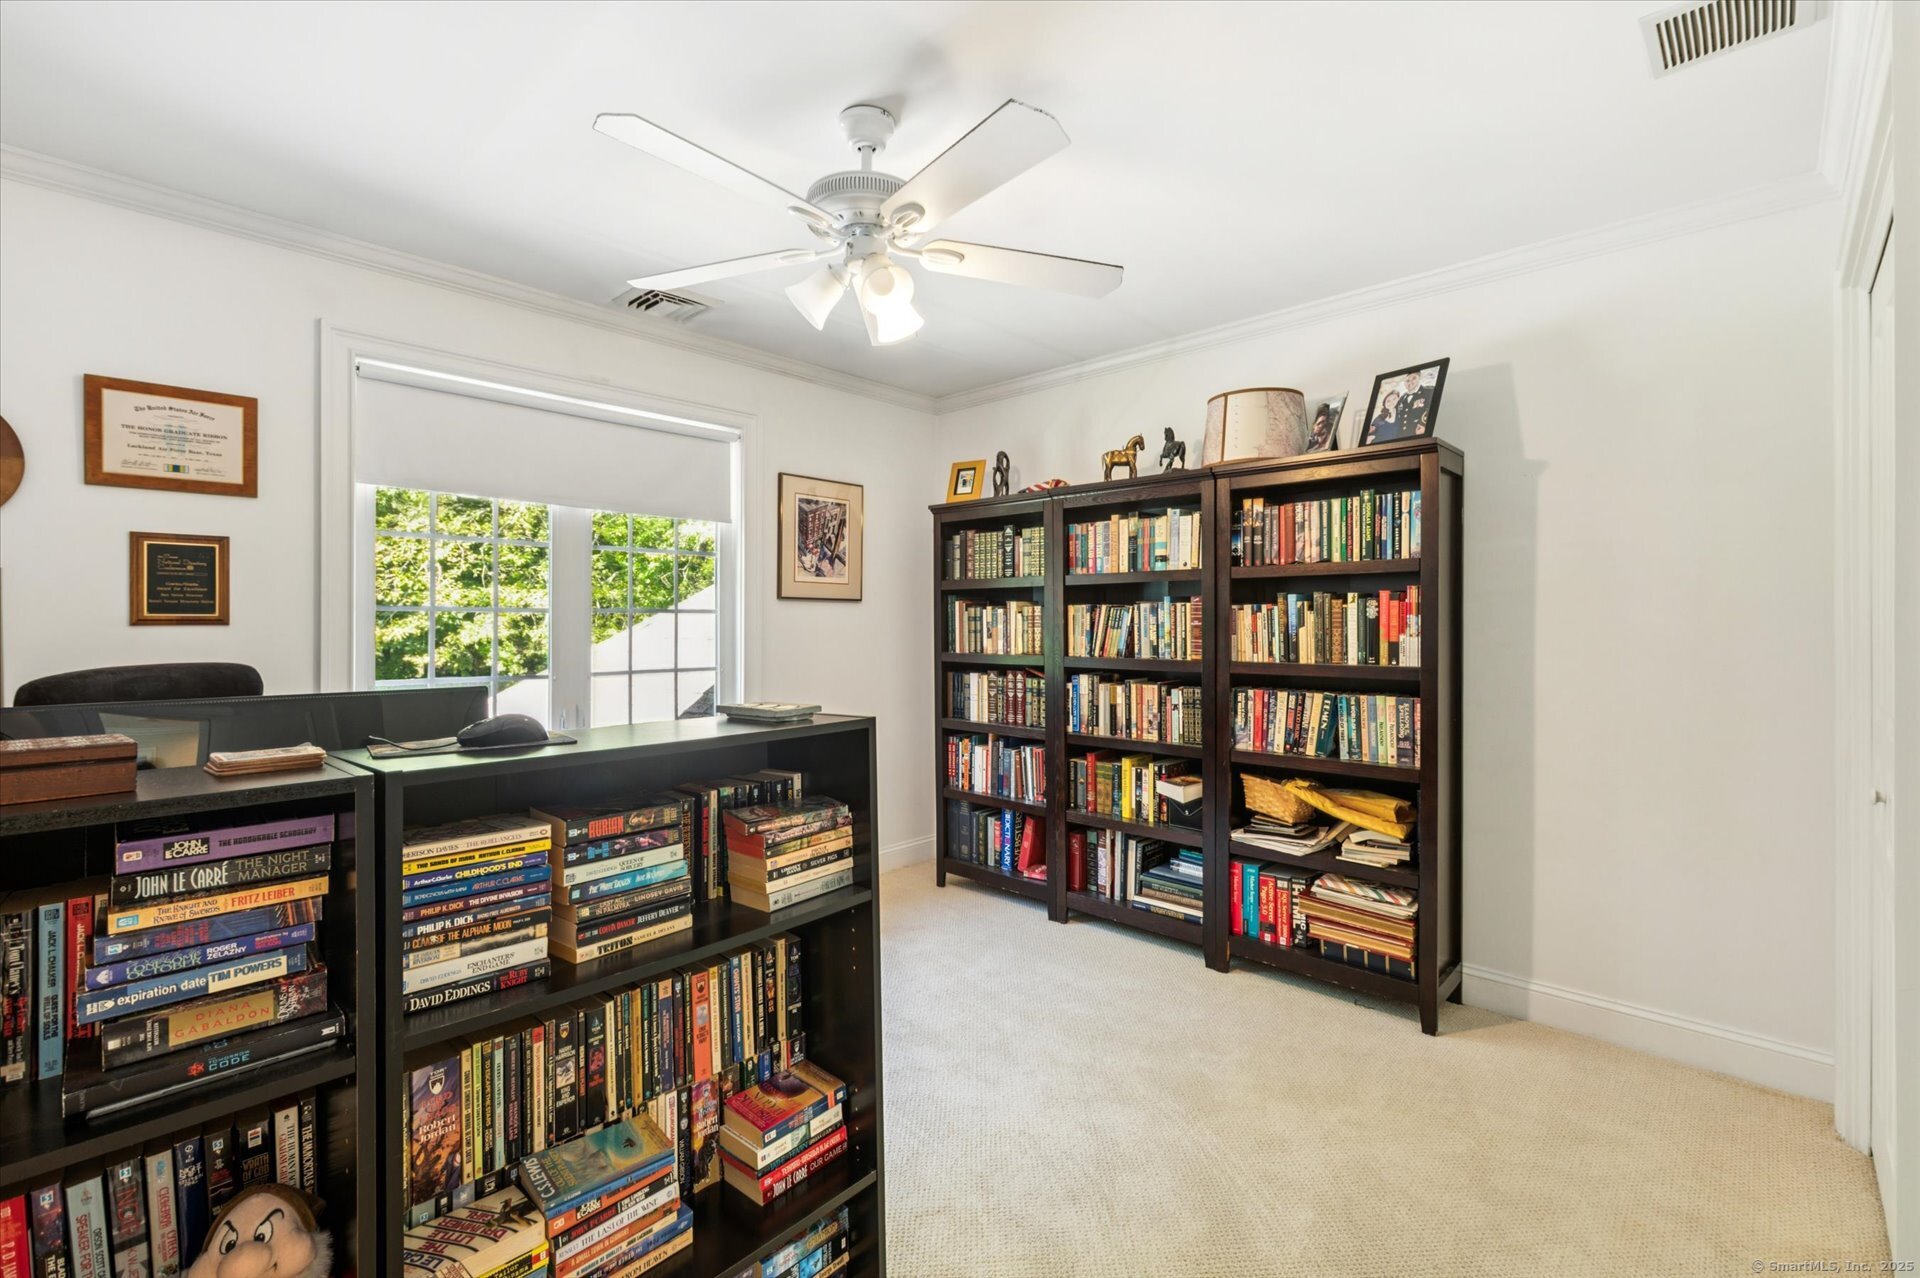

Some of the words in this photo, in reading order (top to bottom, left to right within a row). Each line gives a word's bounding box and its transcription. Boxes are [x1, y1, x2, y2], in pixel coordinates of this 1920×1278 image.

[588, 815, 624, 839] AURIAN
[171, 839, 202, 851] JOHN
[218, 838, 232, 848] THE
[235, 859, 263, 870] THE
[267, 850, 310, 865] NIGHT
[417, 861, 428, 869] THE
[429, 859, 449, 868] SANDS
[458, 854, 476, 862] MARS
[454, 861, 507, 879] CHILDHOOD'S
[508, 860, 524, 869] END
[810, 857, 826, 867] SILVER
[827, 853, 838, 862] PIGS
[134, 875, 168, 899] JOHN
[173, 871, 186, 893] LE
[190, 861, 229, 889] CARRÉ
[238, 861, 307, 882] MANAGER
[231, 894, 260, 908] FRITZ
[262, 887, 295, 903] LEIBER
[420, 905, 442, 916] PHILIP
[442, 904, 449, 912] K.
[449, 901, 465, 911] DICK
[480, 894, 498, 904] DIVINE
[498, 889, 524, 899] INVASION
[634, 890, 663, 902] LINDSEY
[664, 884, 684, 895] DAVIS
[77, 923, 85, 944] JACK
[417, 921, 445, 935] PHILIP
[445, 919, 453, 929] K.
[453, 914, 474, 926] DICK
[448, 930, 461, 940] THE
[461, 924, 491, 938] ALPHANE
[492, 919, 513, 931] MOON
[48, 930, 56, 948] JACK
[206, 942, 238, 954] ROGER
[596, 936, 633, 954] TRITON
[206, 945, 247, 960] ZELAZNY
[47, 955, 57, 988] CHALKER
[127, 961, 201, 980] OCTOBER
[209, 971, 231, 983] TIM
[233, 957, 282, 977] POWERS
[508, 967, 529, 979] RUBY
[117, 980, 178, 1006] expiration
[180, 976, 207, 992] date
[500, 975, 528, 990] KNIGHT
[409, 993, 443, 1012] DAVID
[444, 980, 491, 1002] EDDINGS
[195, 1001, 251, 1022] DIANA
[174, 1007, 270, 1039] GABALDON
[209, 1055, 250, 1071] CODE
[302, 1124, 313, 1143] THE
[419, 1114, 456, 1135] Robert
[419, 1123, 456, 1145] Jordan
[279, 1133, 288, 1164] GRAHAM
[242, 1153, 270, 1173] WRATH
[302, 1143, 313, 1186] IMMORTALS
[523, 1157, 548, 1186] LEWIS
[243, 1170, 253, 1182] OF
[254, 1166, 270, 1180] GOD
[773, 1179, 786, 1198] JOHN
[793, 1163, 808, 1185] CARRÉ
[809, 1155, 824, 1171] OUR
[536, 1180, 556, 1198] C.S.
[465, 1210, 496, 1223] GIRL
[581, 1233, 596, 1247] THE
[597, 1223, 614, 1238] LAST
[615, 1217, 625, 1228] OF
[626, 1208, 639, 1221] THE
[640, 1197, 659, 1212] WINE
[75, 1214, 90, 1254] SPEAKER
[92, 1228, 103, 1250] ORSON
[428, 1229, 476, 1245] LITTLE
[437, 1218, 508, 1240] DRUMMER
[417, 1241, 448, 1254] THE
[80, 1254, 92, 1271] FOR
[94, 1250, 105, 1269] SCOTT
[425, 1256, 445, 1269] LE
[642, 1250, 668, 1270] HEAVEN
[494, 1264, 520, 1278] Tailor
